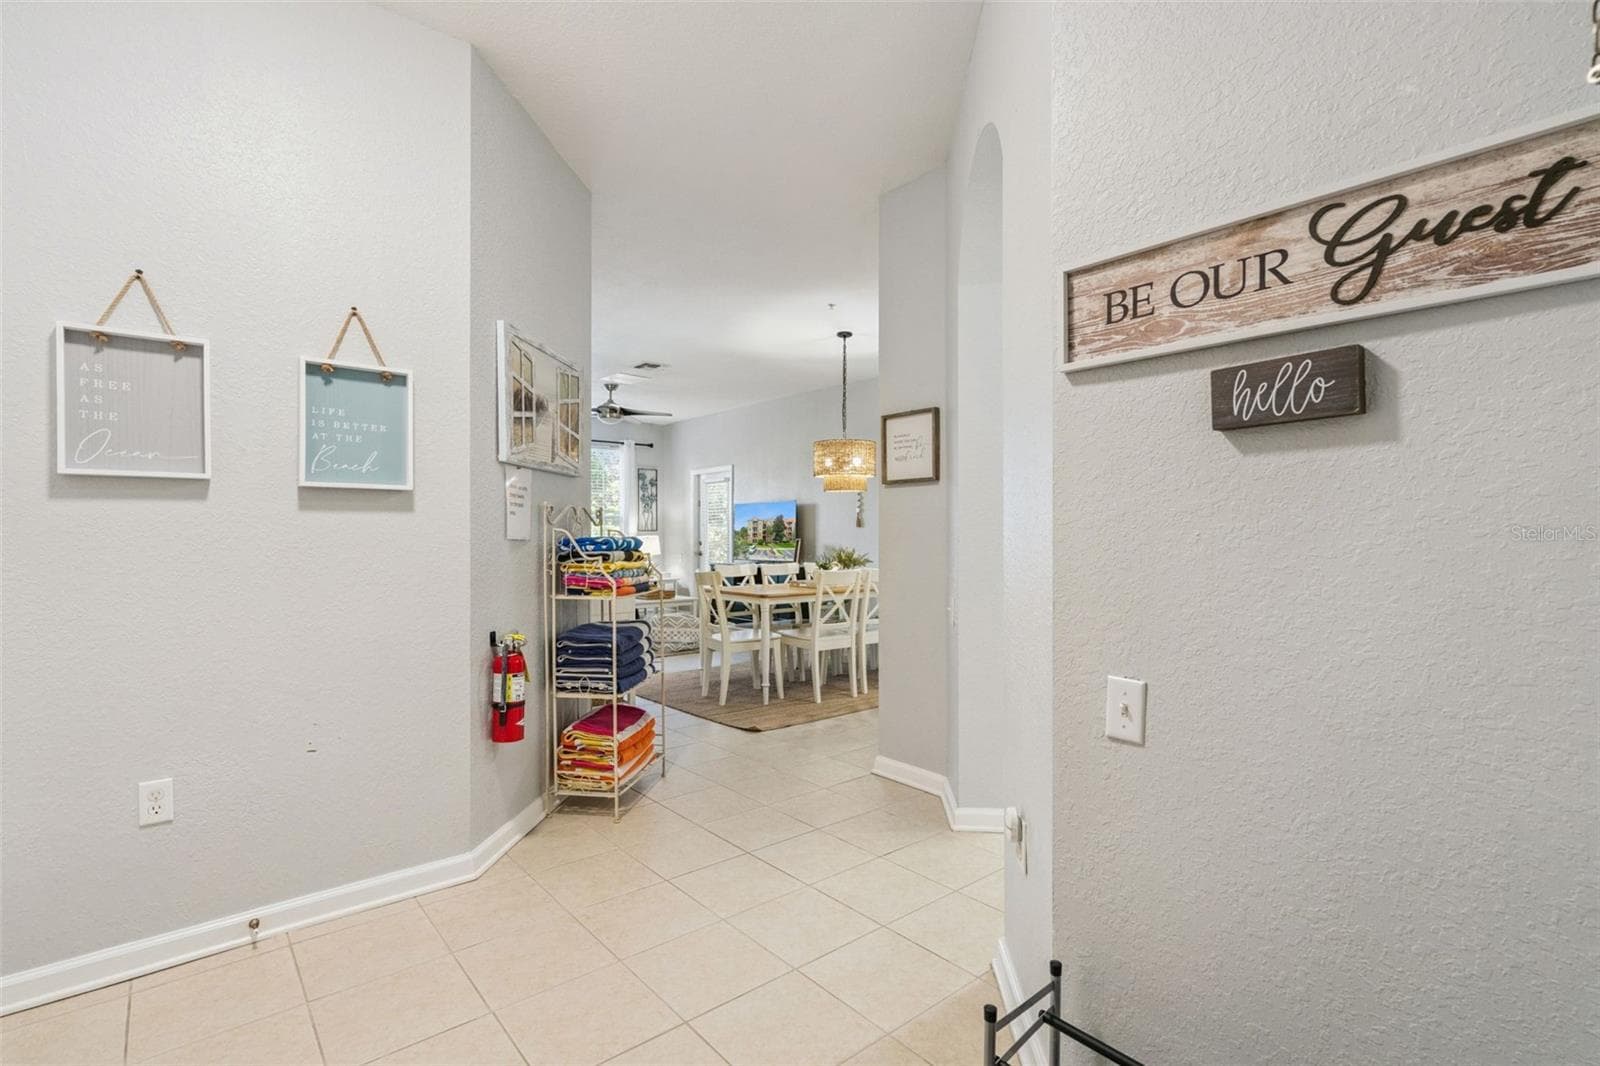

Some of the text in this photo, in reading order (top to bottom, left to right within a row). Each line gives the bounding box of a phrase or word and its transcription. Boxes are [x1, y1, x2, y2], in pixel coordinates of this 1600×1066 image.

[1103, 155, 1589, 325] BE OUR Guest
[79, 362, 104, 373] AS
[79, 378, 132, 391] FREE
[1232, 358, 1335, 422] hello
[79, 394, 104, 404] AS
[78, 409, 119, 421] THE
[311, 406, 346, 417] LIFE
[311, 419, 388, 432] IS BETTER
[311, 432, 363, 443] AT THE
[74, 428, 198, 464] Ocean
[310, 443, 381, 474] Beach
